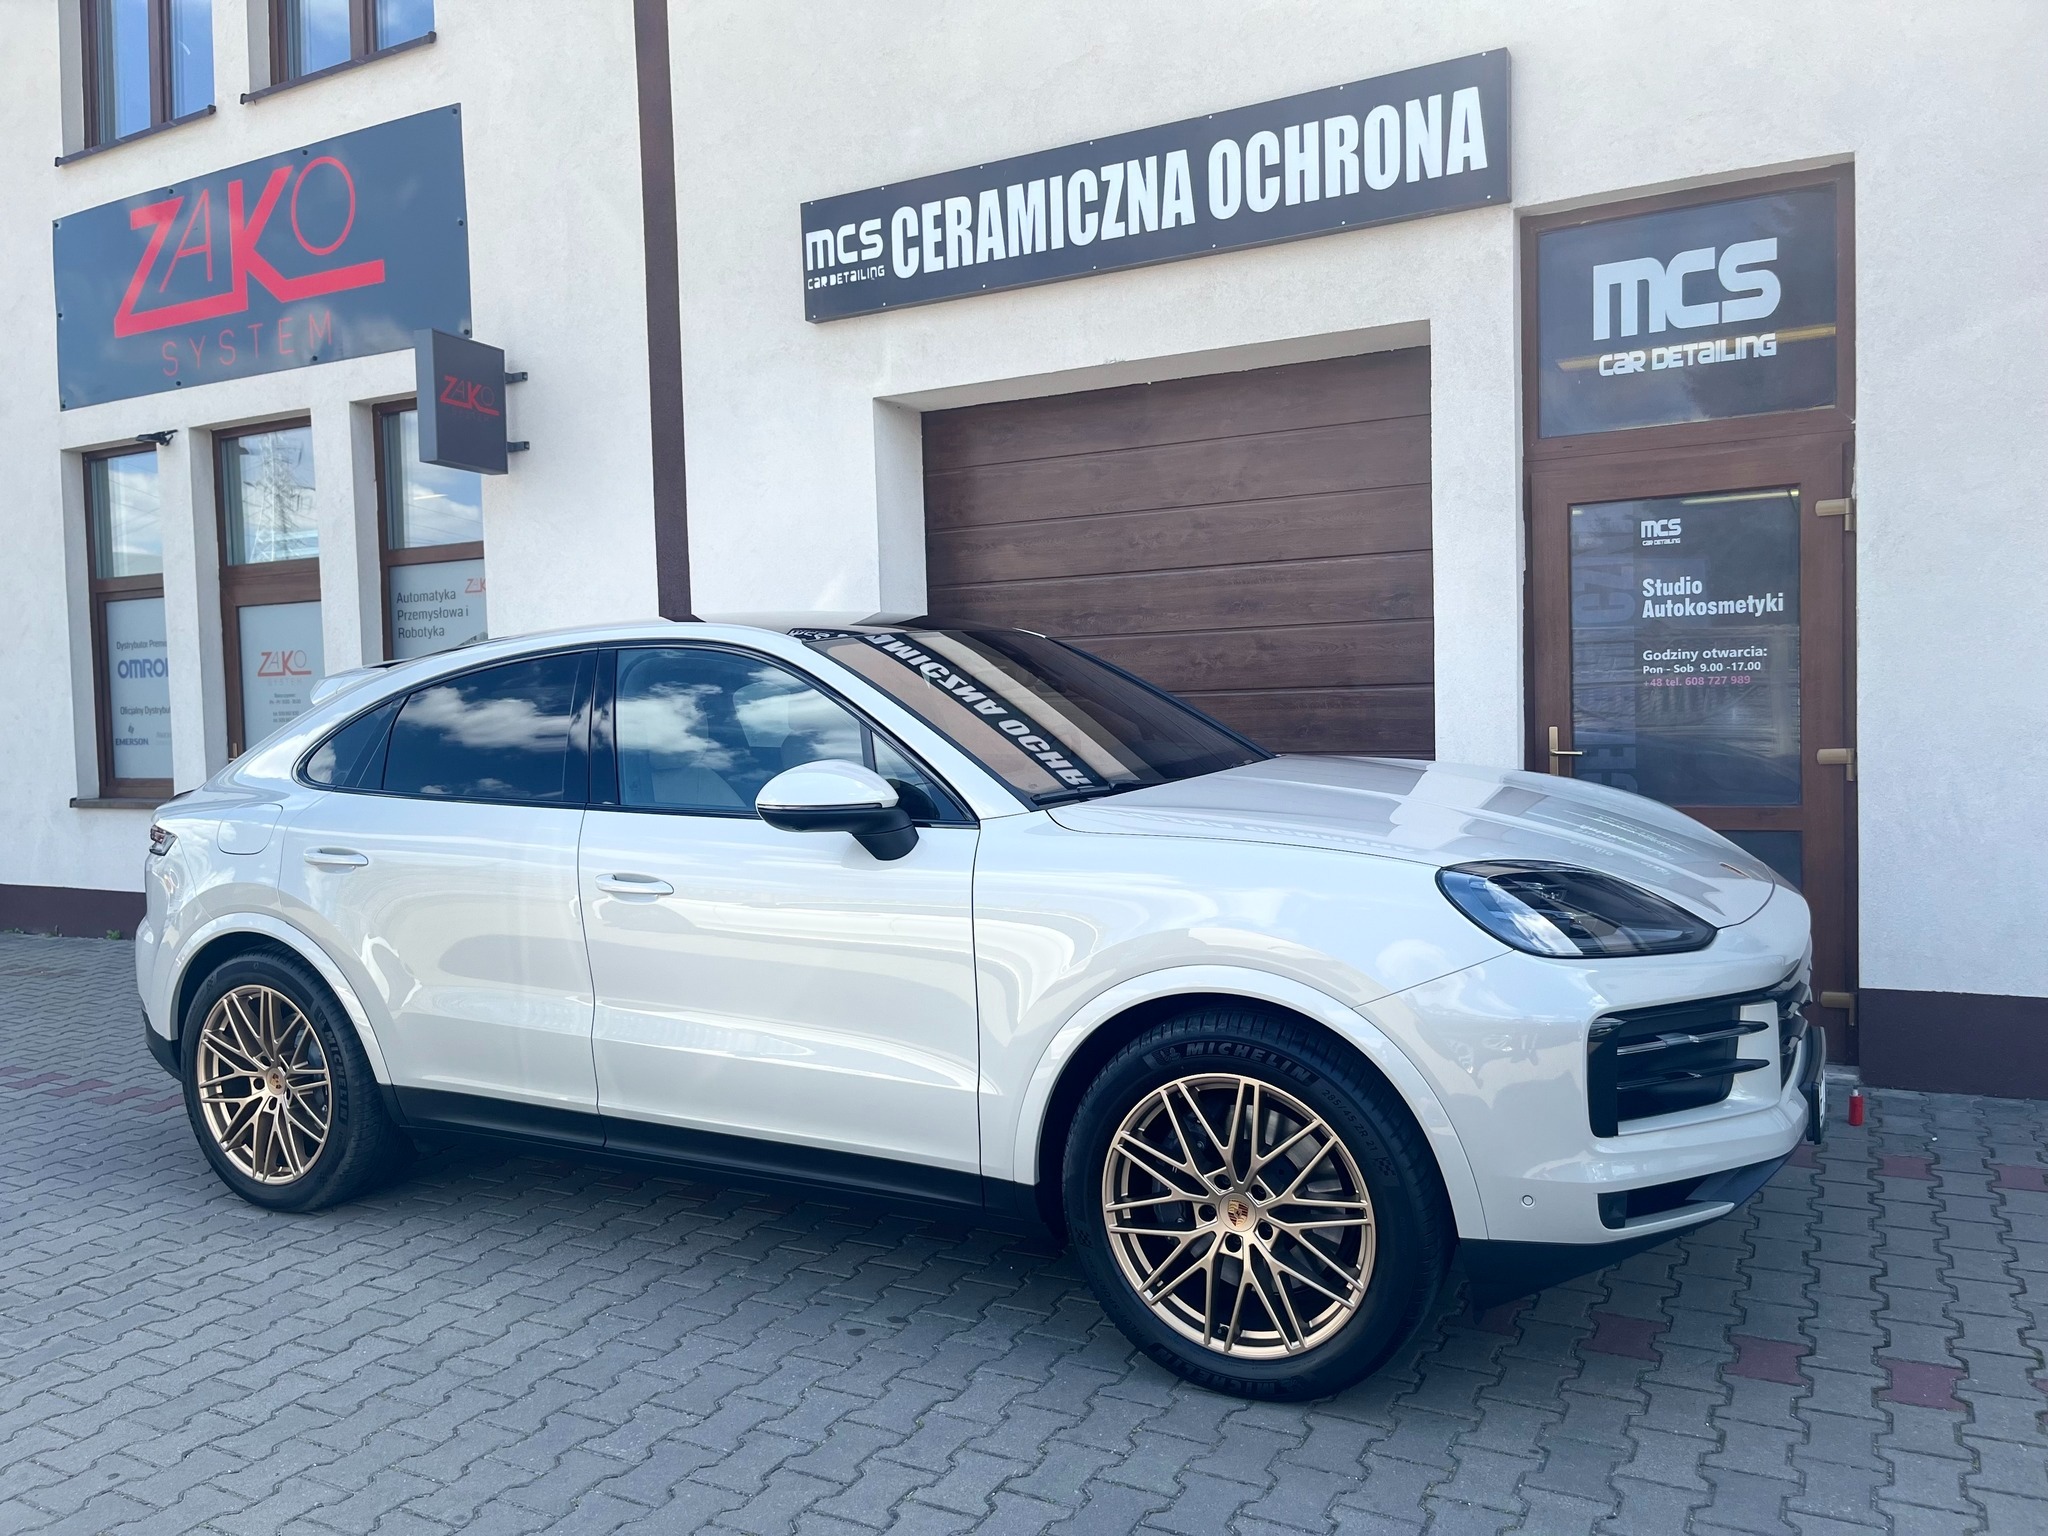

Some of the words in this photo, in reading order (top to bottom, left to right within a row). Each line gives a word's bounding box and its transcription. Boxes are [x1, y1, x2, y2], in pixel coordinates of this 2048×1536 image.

[891, 149, 1196, 279] CERAMICZNA
[1208, 86, 1488, 220] OCHRONA
[114, 156, 385, 338] ZAKO
[805, 218, 884, 271] MCS
[1593, 237, 1781, 341] MCS
[162, 311, 332, 376] SYSTEM
[440, 375, 500, 417] ZAKO
[1641, 518, 1682, 538] MCS
[396, 589, 456, 604] Automatyka
[1642, 576, 1703, 597] Studio
[397, 606, 463, 621] Przemysłowa
[1642, 592, 1784, 618] Autokosmetyki
[398, 625, 445, 639] Robotyka
[257, 650, 312, 677] ZAKO
[1642, 649, 1698, 662] Godziny
[1702, 646, 1768, 659] otwarcia:
[1643, 665, 1663, 674] Pon
[1673, 664, 1694, 673] Sob
[1700, 663, 1723, 672] 9.00
[1643, 678, 1662, 687] +48
[1666, 677, 1682, 686] tel.
[1685, 677, 1705, 686] 608
[1708, 676, 1727, 685] 727
[1730, 675, 1751, 684] 989
[115, 738, 149, 746] EMERSON
[1186, 1042, 1311, 1081] MICHELIN
